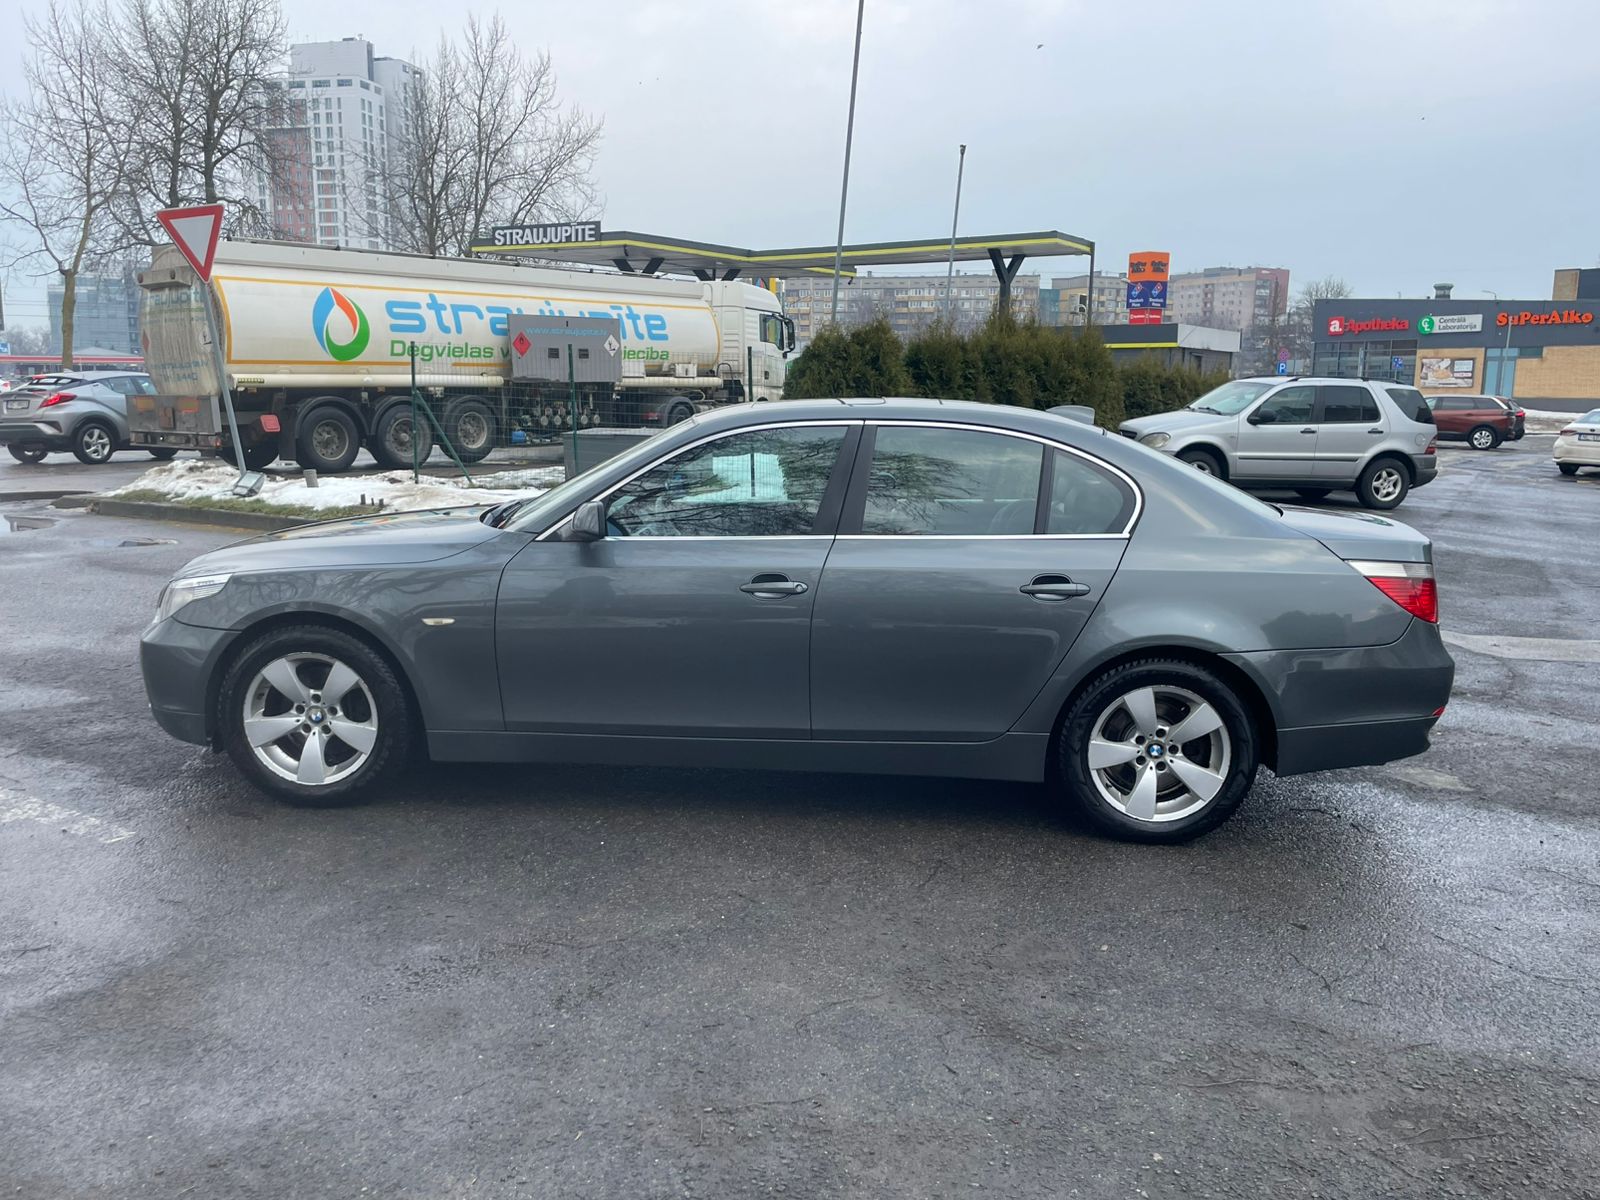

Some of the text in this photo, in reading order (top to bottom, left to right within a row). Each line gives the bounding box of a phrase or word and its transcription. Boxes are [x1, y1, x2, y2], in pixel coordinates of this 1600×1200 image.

[494, 222, 596, 246] STRAUJUPĪTE
[385, 293, 669, 341] straīte
[1347, 317, 1409, 334] Apotheka
[1438, 323, 1477, 331] Laboratorija
[389, 340, 494, 362] Degvielas
